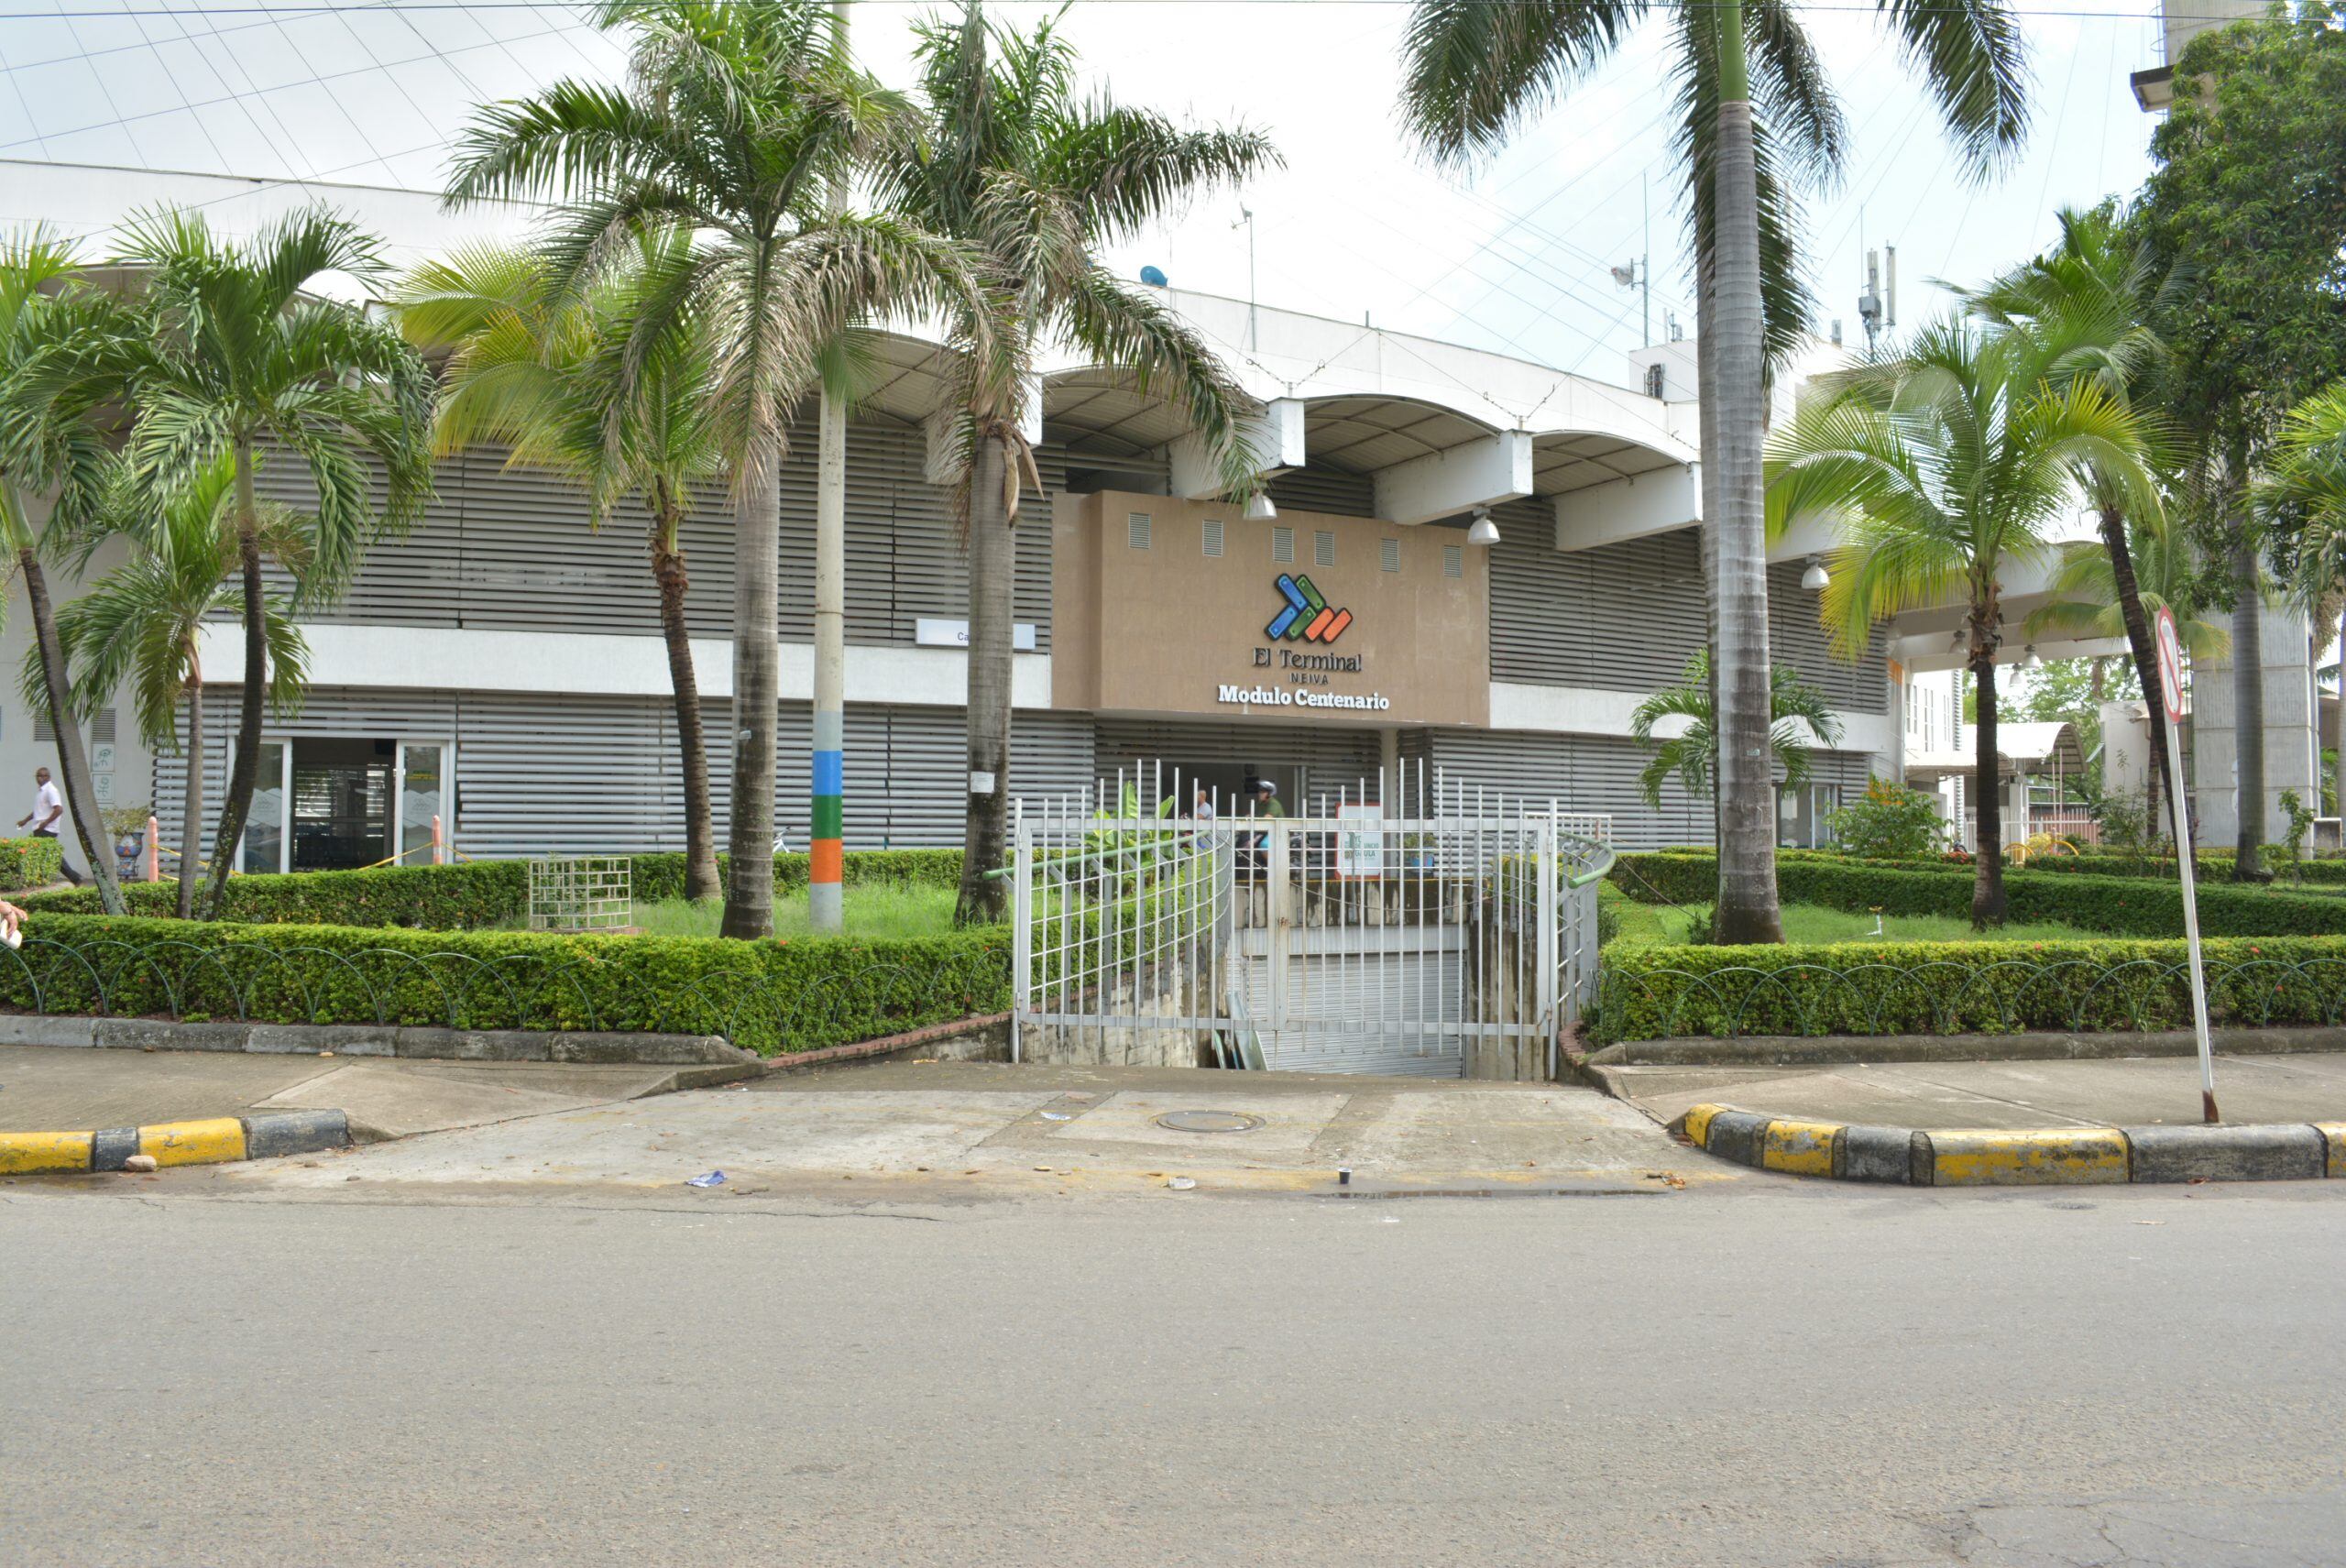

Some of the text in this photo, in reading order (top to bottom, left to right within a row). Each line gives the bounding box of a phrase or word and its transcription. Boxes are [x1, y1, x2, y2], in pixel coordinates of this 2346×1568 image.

[1253, 647, 1362, 672] El Terminal
[1290, 673, 1329, 685] NEIVA
[1218, 685, 1389, 709] Modulo Centenario
